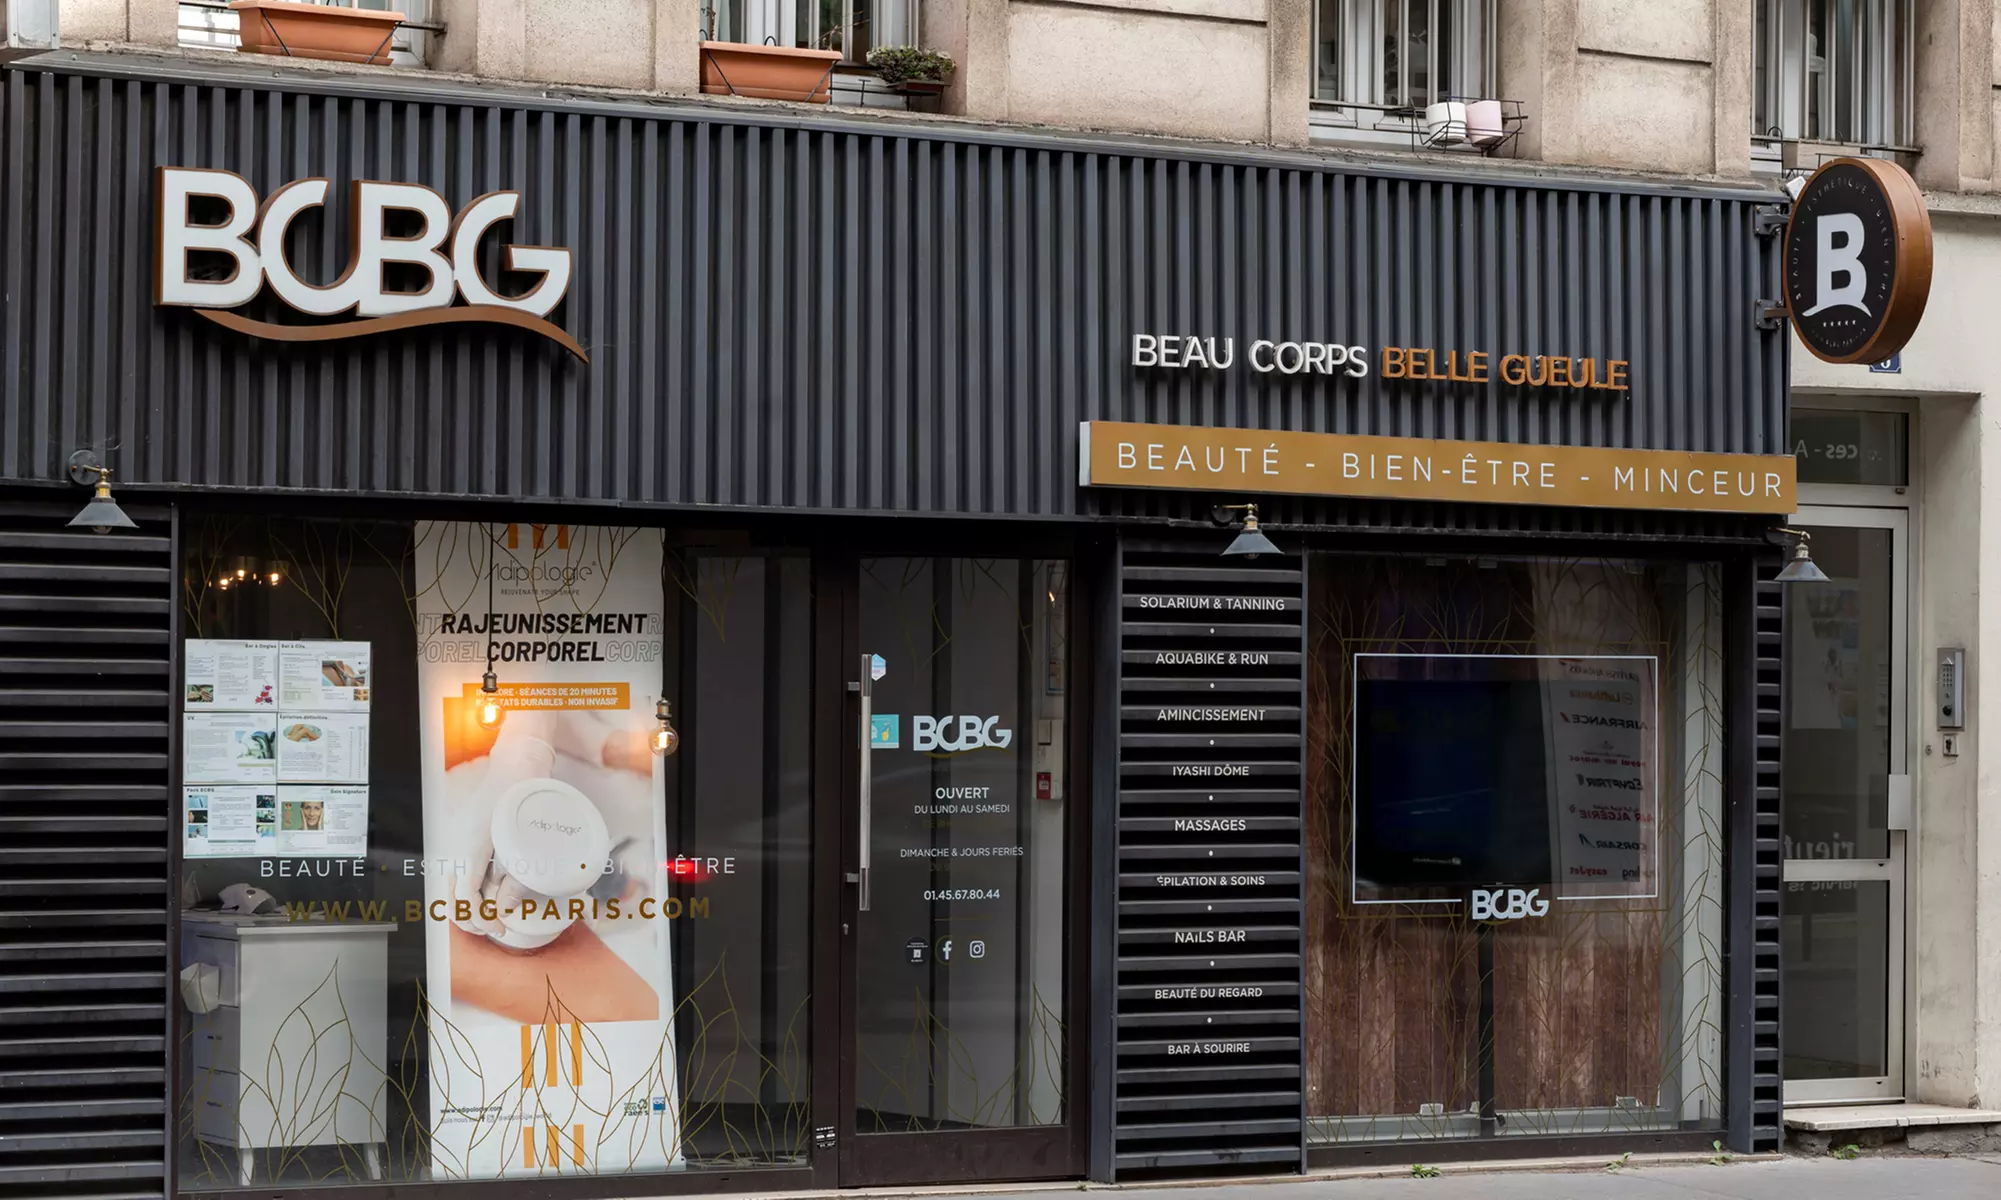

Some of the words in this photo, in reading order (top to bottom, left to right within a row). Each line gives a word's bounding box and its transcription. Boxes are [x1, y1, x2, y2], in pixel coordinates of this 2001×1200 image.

[154, 166, 572, 318] BCBG
[1815, 212, 1868, 310] B
[1132, 333, 1234, 370] BEAU
[1249, 338, 1369, 378] CORPS
[1381, 346, 1489, 383] BELLE
[1500, 353, 1629, 391] GUEULE
[1117, 443, 1280, 475] BEAUTÉ
[1342, 453, 1556, 488] BIEN-ÊTRE
[1614, 466, 1783, 498] MINCEUR
[1140, 596, 1210, 609] SOLARIUM
[1213, 599, 1222, 610] &
[1226, 598, 1285, 611] TANNING
[441, 613, 648, 634] RAJEUNISSEMENT
[487, 641, 605, 662] CORPOREL
[1155, 652, 1225, 665] AQUABIKE
[1228, 653, 1237, 665] &
[1241, 653, 1269, 665] RUN
[519, 685, 557, 696] SÉANCES
[570, 687, 580, 696] 20
[581, 687, 618, 696] MINUTES
[521, 698, 564, 707] DURABLES
[567, 697, 585, 706] NON
[586, 697, 618, 706] INVASIF
[1157, 708, 1266, 721] AMINCISSEMENT
[912, 715, 1012, 752] BCBG
[1172, 766, 1211, 776] IYASHI
[1214, 763, 1250, 776] DÔME
[935, 787, 990, 799] OUVERT
[914, 805, 928, 814] DU
[930, 805, 958, 814] LUNDI
[960, 805, 974, 813] AU
[975, 804, 1010, 813] SAMEDI
[1174, 819, 1246, 832] MASSAGES
[900, 848, 949, 858] DIMANCHE
[951, 848, 958, 857] &
[959, 847, 991, 857] JOURS
[260, 856, 365, 877] BEAUTÉ
[1219, 876, 1228, 886] &
[1230, 875, 1266, 886] SOINS
[923, 889, 1001, 900] 01.45.67.80.44
[286, 896, 710, 923] WWW.BCBG-PARIS.COM
[1471, 888, 1550, 920] BCBG
[1218, 930, 1246, 943] BAR
[1154, 986, 1198, 1000] BEAUTÉ
[1200, 988, 1216, 998] DU
[1218, 987, 1263, 998] REGARD
[1168, 1044, 1191, 1055] BAR
[1193, 1041, 1202, 1054] À
[1204, 1043, 1250, 1054] SOURIRE
